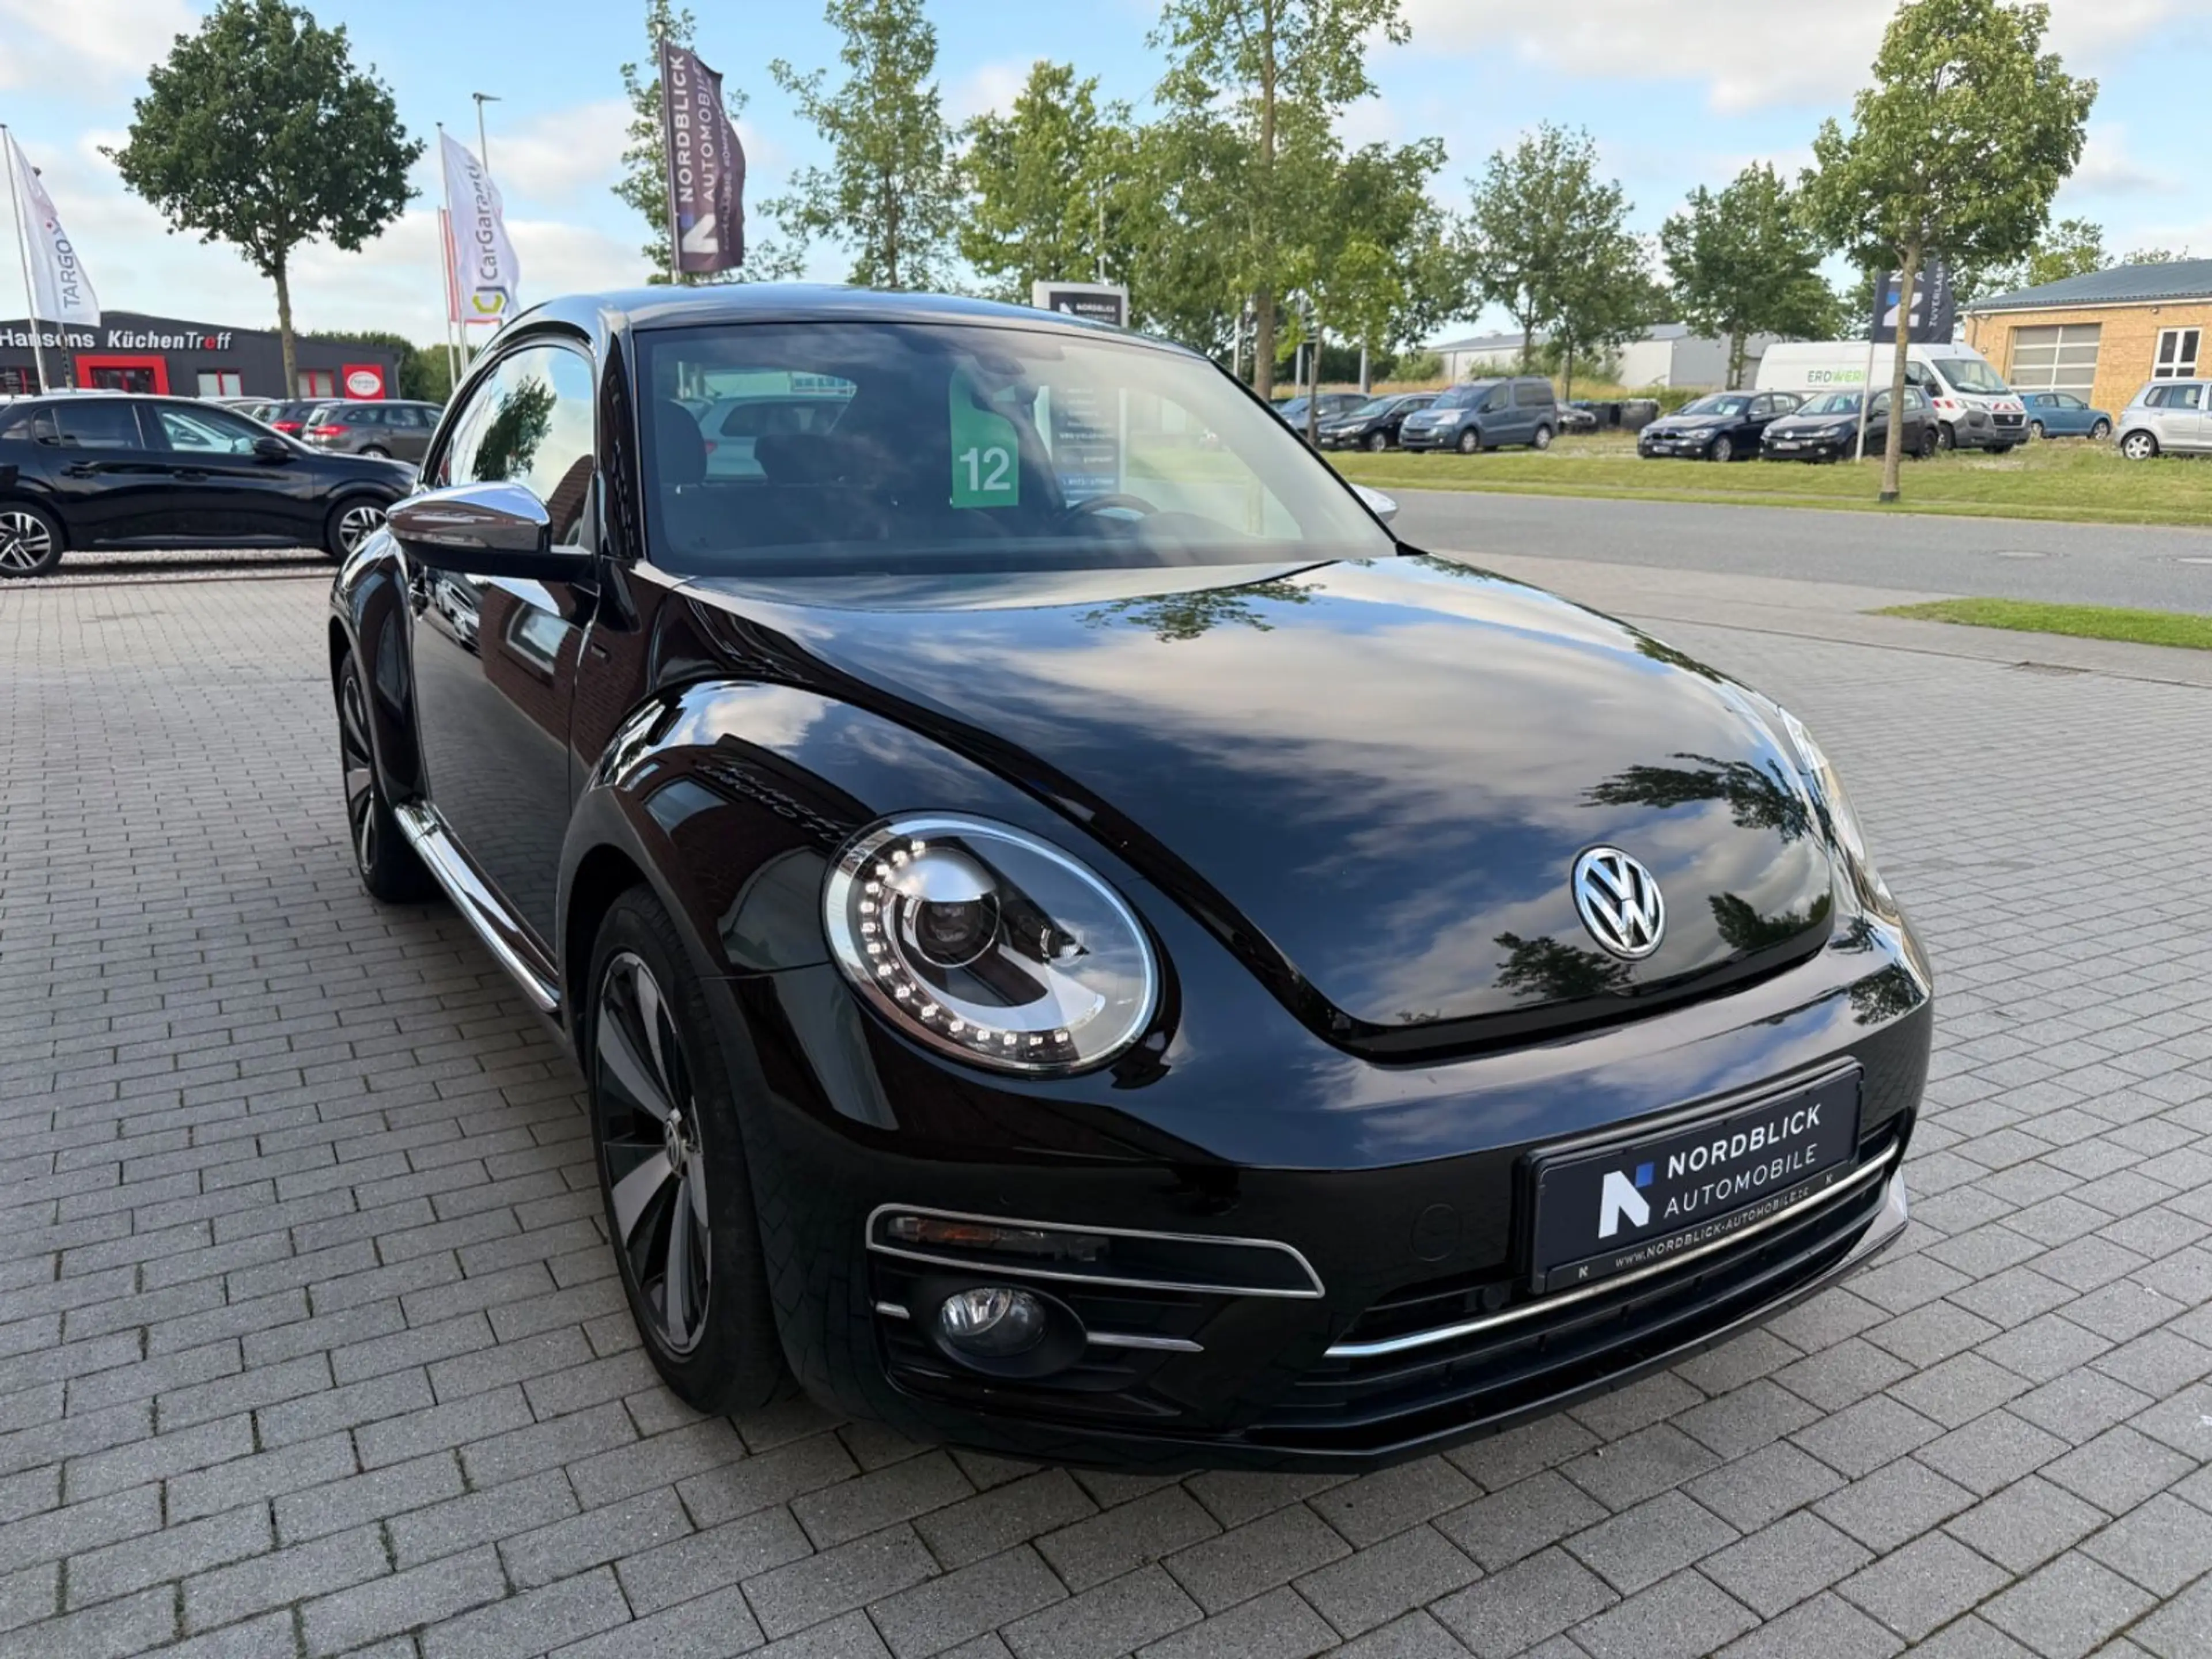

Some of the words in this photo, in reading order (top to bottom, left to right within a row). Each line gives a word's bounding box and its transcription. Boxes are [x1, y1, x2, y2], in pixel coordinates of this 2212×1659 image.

[669, 55, 694, 202] NORDBLICK
[692, 60, 715, 202] AUTOMOBILE
[55, 238, 81, 309] TARGO
[0, 329, 95, 348] Hansons
[107, 329, 232, 350] KüchenTreff
[959, 446, 1012, 491] 12
[1667, 1103, 1821, 1179] NORDBLICK
[1663, 1143, 1818, 1219] AUTOMOBILE
